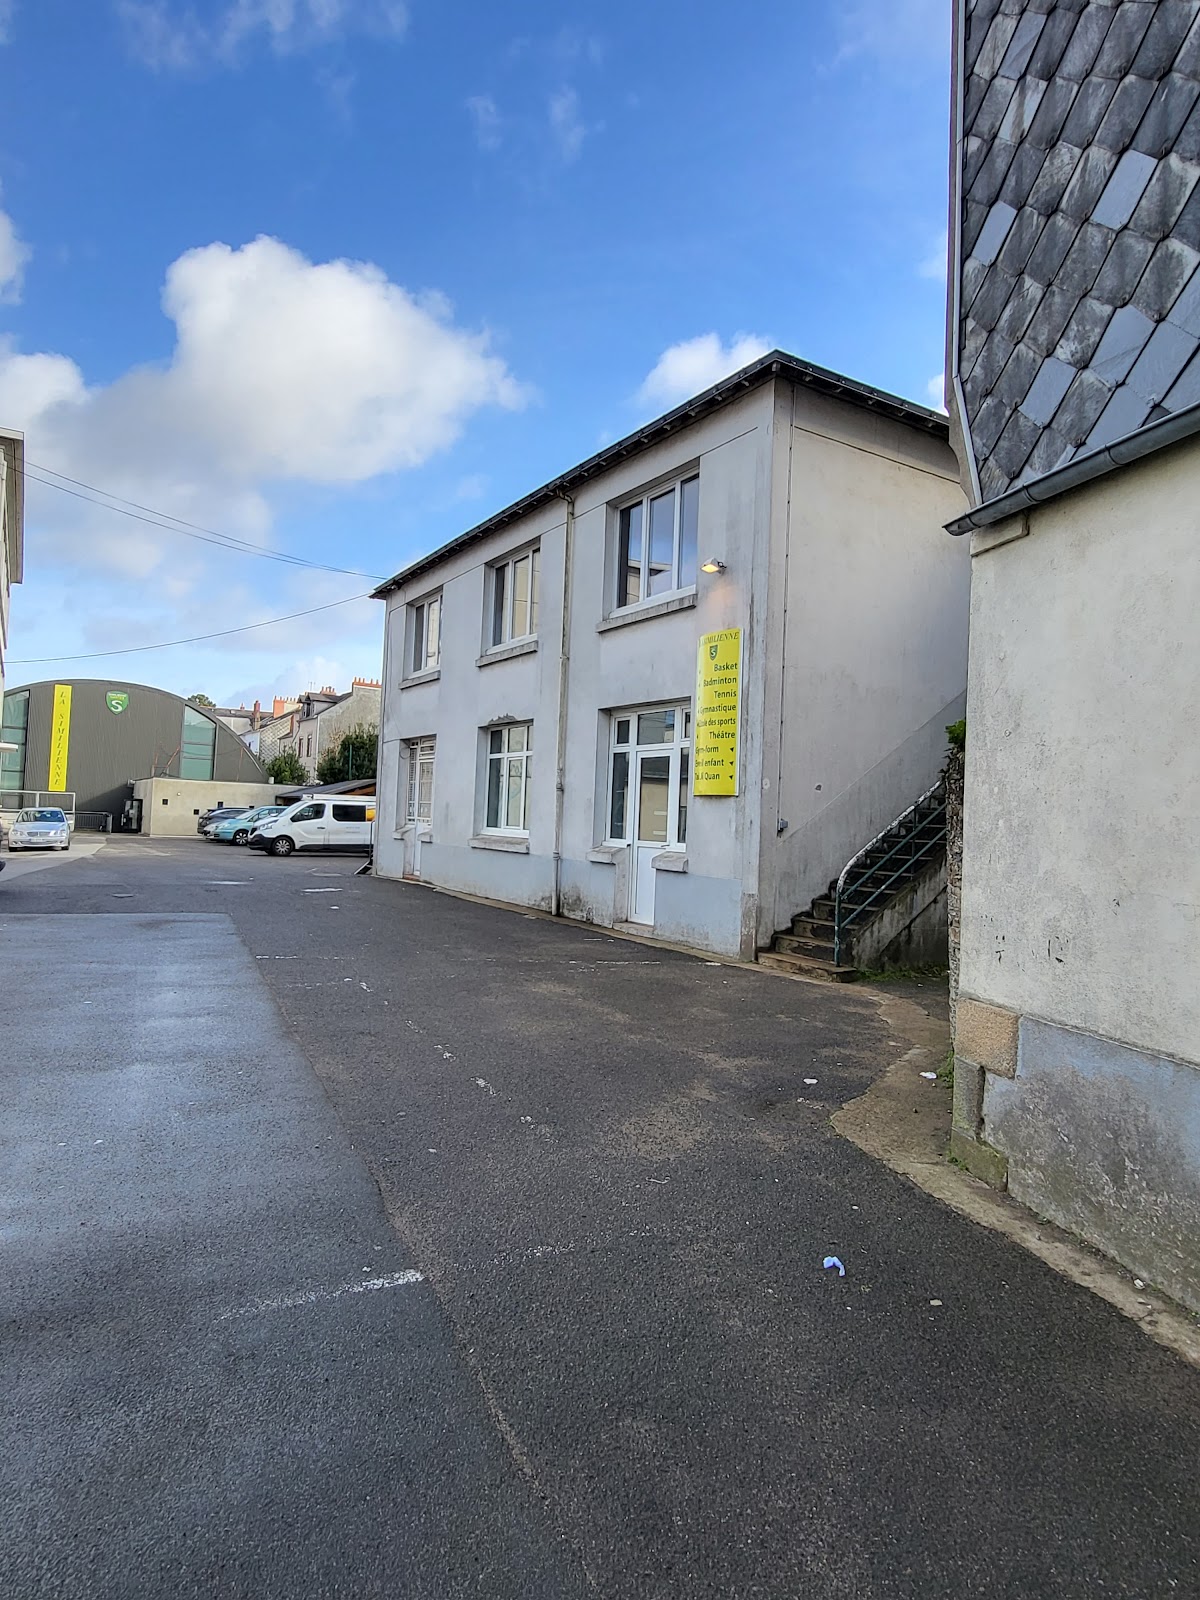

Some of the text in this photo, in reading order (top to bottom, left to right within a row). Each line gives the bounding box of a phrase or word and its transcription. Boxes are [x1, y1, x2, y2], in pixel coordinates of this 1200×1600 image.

[714, 662, 738, 672] Basket
[703, 676, 737, 688] Badminton
[714, 689, 737, 699] Tennis
[111, 699, 122, 712] S
[708, 718, 716, 726] des
[717, 717, 736, 728] sports
[54, 691, 66, 786] LA SIMILIENNE
[709, 730, 736, 740] Théâtre
[705, 757, 725, 767] enfant
[705, 771, 721, 781] Quan
